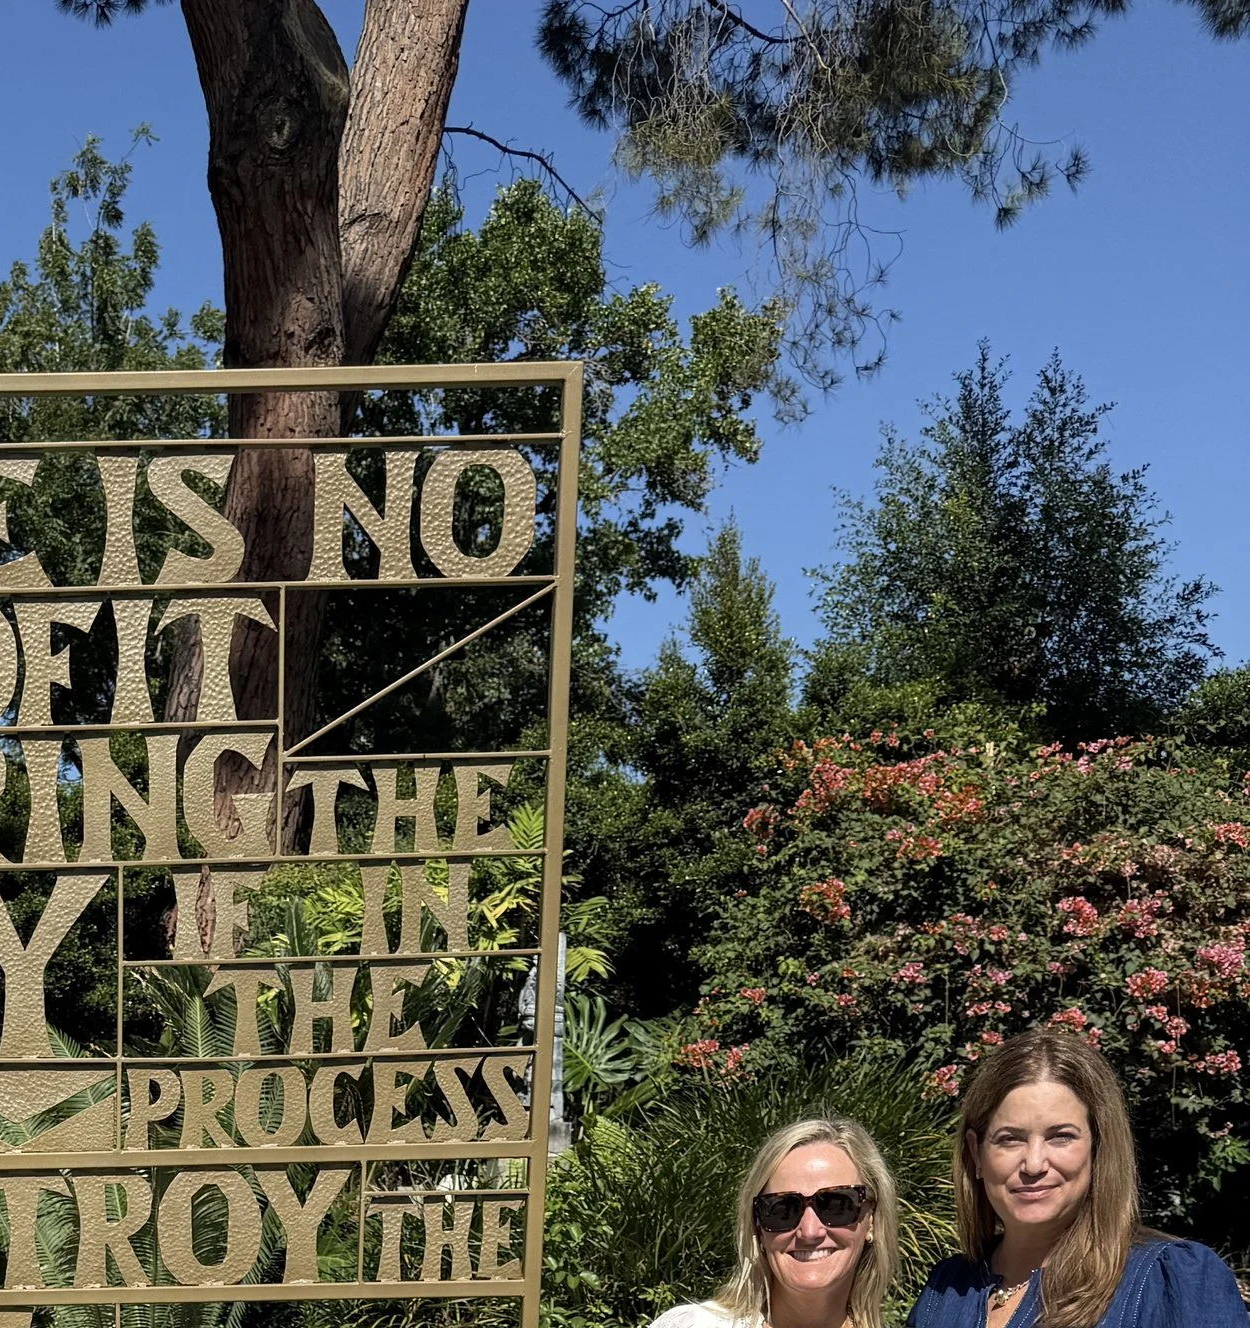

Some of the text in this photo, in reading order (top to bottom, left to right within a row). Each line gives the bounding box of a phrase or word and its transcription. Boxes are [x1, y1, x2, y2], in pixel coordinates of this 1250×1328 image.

[97, 452, 245, 585] IS
[306, 449, 536, 580] NO
[285, 762, 516, 856] THE
[170, 864, 263, 960] IF
[361, 859, 470, 955] IN
[203, 963, 434, 1057] THE
[126, 1056, 534, 1150] PROCESS
[366, 1201, 526, 1283] THE
